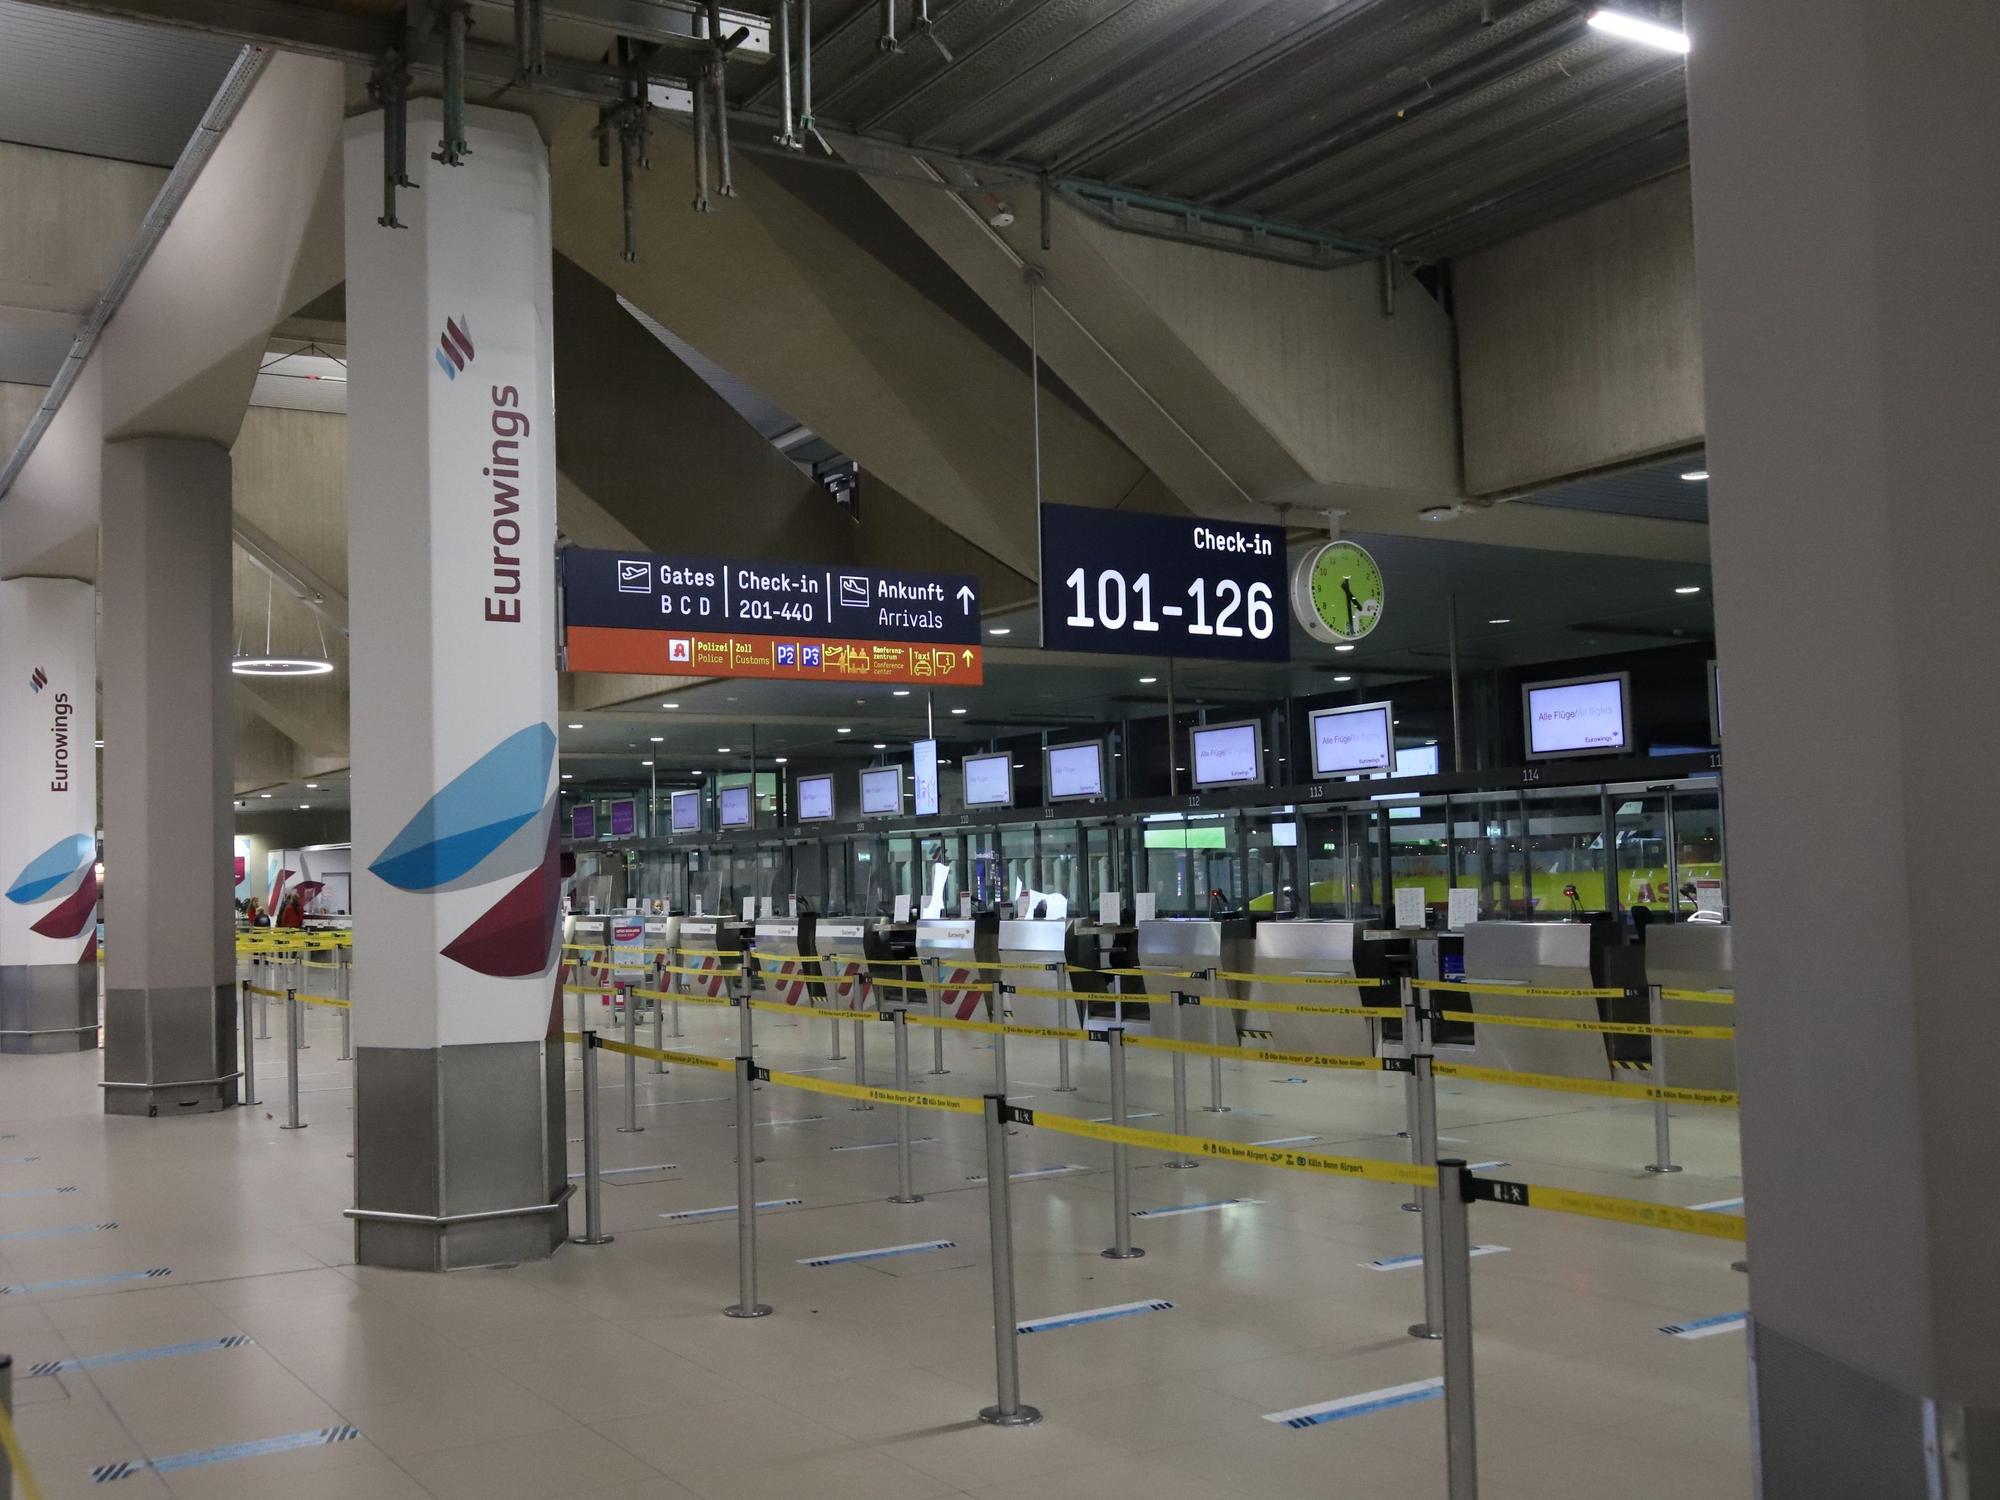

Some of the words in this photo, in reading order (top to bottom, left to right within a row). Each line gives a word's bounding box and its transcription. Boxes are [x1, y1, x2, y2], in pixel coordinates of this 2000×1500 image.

[483, 385, 530, 622] Eurowings
[1194, 527, 1272, 555] Check-in
[660, 565, 715, 587] Gates
[738, 570, 819, 594] Check-in
[878, 580, 945, 602] Ankunft
[661, 595, 672, 614] B
[680, 596, 691, 615] C
[699, 597, 711, 616] D
[739, 600, 813, 622] 201-440
[1066, 568, 1274, 640] 101-126
[878, 608, 943, 629] Arrivals
[697, 641, 728, 652] Polizei
[735, 643, 752, 653] Zoll
[778, 646, 794, 664] P2
[698, 653, 723, 663] Police
[735, 654, 770, 665] Customs
[803, 647, 820, 665] P3
[914, 651, 930, 661] Taxi
[1538, 712, 1552, 721] Alle
[51, 693, 73, 792] Eurowings
[1522, 768, 1539, 782] 114
[1310, 786, 1323, 798] 113
[1189, 796, 1200, 807] 112
[1232, 1147, 1245, 1156] Bonn
[1246, 1149, 1268, 1161] Airport
[1323, 1160, 1338, 1169] Bonn
[1340, 1162, 1364, 1173] Airport
